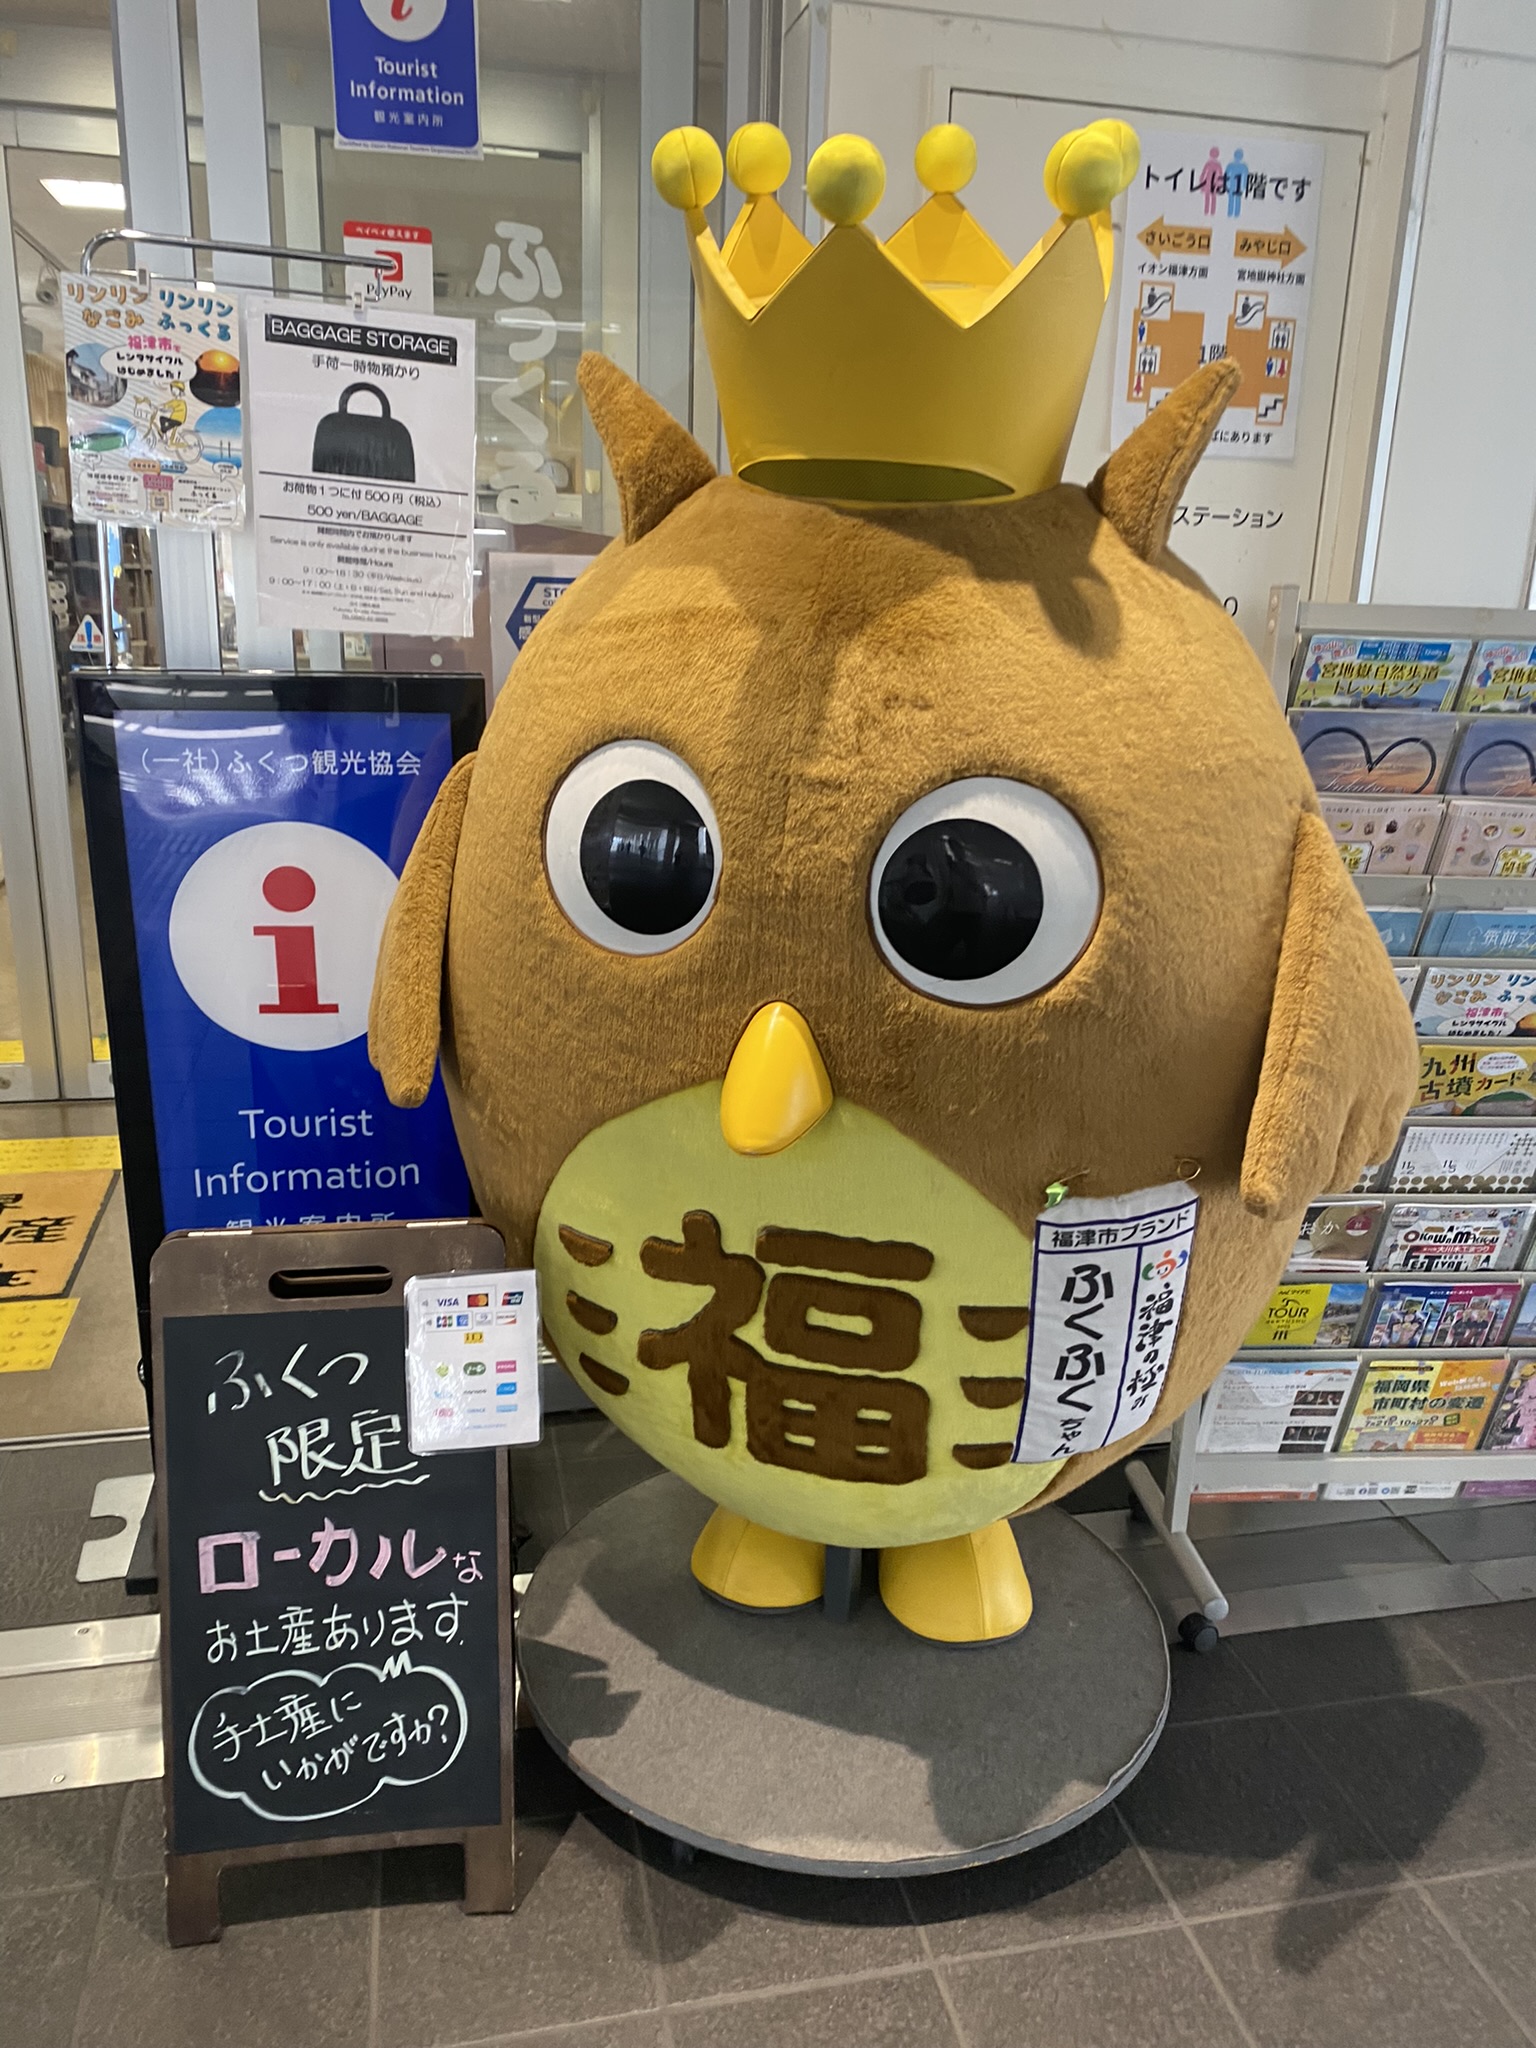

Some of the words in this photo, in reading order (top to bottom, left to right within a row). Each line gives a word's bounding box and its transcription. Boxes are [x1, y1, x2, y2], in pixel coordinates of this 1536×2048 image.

[374, 56, 438, 79] Tourist
[350, 79, 464, 105] Information
[374, 109, 443, 127] 観光案内所
[1145, 164, 1311, 202] トイレは1階です
[1145, 231, 1210, 250] さいごう口
[1240, 237, 1291, 256] みやじ口
[1137, 262, 1208, 279] イオン福津方面
[67, 283, 148, 305] リンリン
[159, 289, 233, 317] リンリン
[82, 308, 145, 329] なごみ
[157, 312, 231, 342] ふっくる
[271, 318, 362, 345] BAGGAGE
[366, 330, 450, 356] STORAGE
[116, 352, 184, 366] レンタサイクル
[313, 354, 420, 380] 手荷一時物預かり
[307, 505, 333, 517] 500
[336, 509, 423, 526] yen/BAGGAGE
[1173, 506, 1284, 529] ステーション
[1321, 661, 1441, 682] 宮地嶽自然歩道
[1334, 680, 1423, 699] トレッキング
[141, 748, 421, 777] （一社）ふくつ観光協会
[1431, 973, 1501, 989] リンリン
[1435, 989, 1488, 1006] なごみ
[1421, 1052, 1477, 1079] 九州
[1418, 1071, 1524, 1102] 古墳カード
[238, 1107, 374, 1139] Tourist
[194, 1160, 420, 1198] Information
[1052, 1209, 1190, 1248] 福津市ブランド
[437, 1297, 459, 1307] VISA
[1269, 1307, 1309, 1318] TOUR
[637, 1209, 934, 1485] 福
[1051, 1264, 1114, 1457] ふくふくちゃん
[207, 1342, 369, 1415] ふくつ
[1373, 1379, 1430, 1394] 福岡県
[265, 1408, 418, 1486] 限定
[198, 1516, 483, 1594] ローカルな
[212, 1690, 362, 1763] 手土産に
[261, 1703, 449, 1791] いかがですか？
